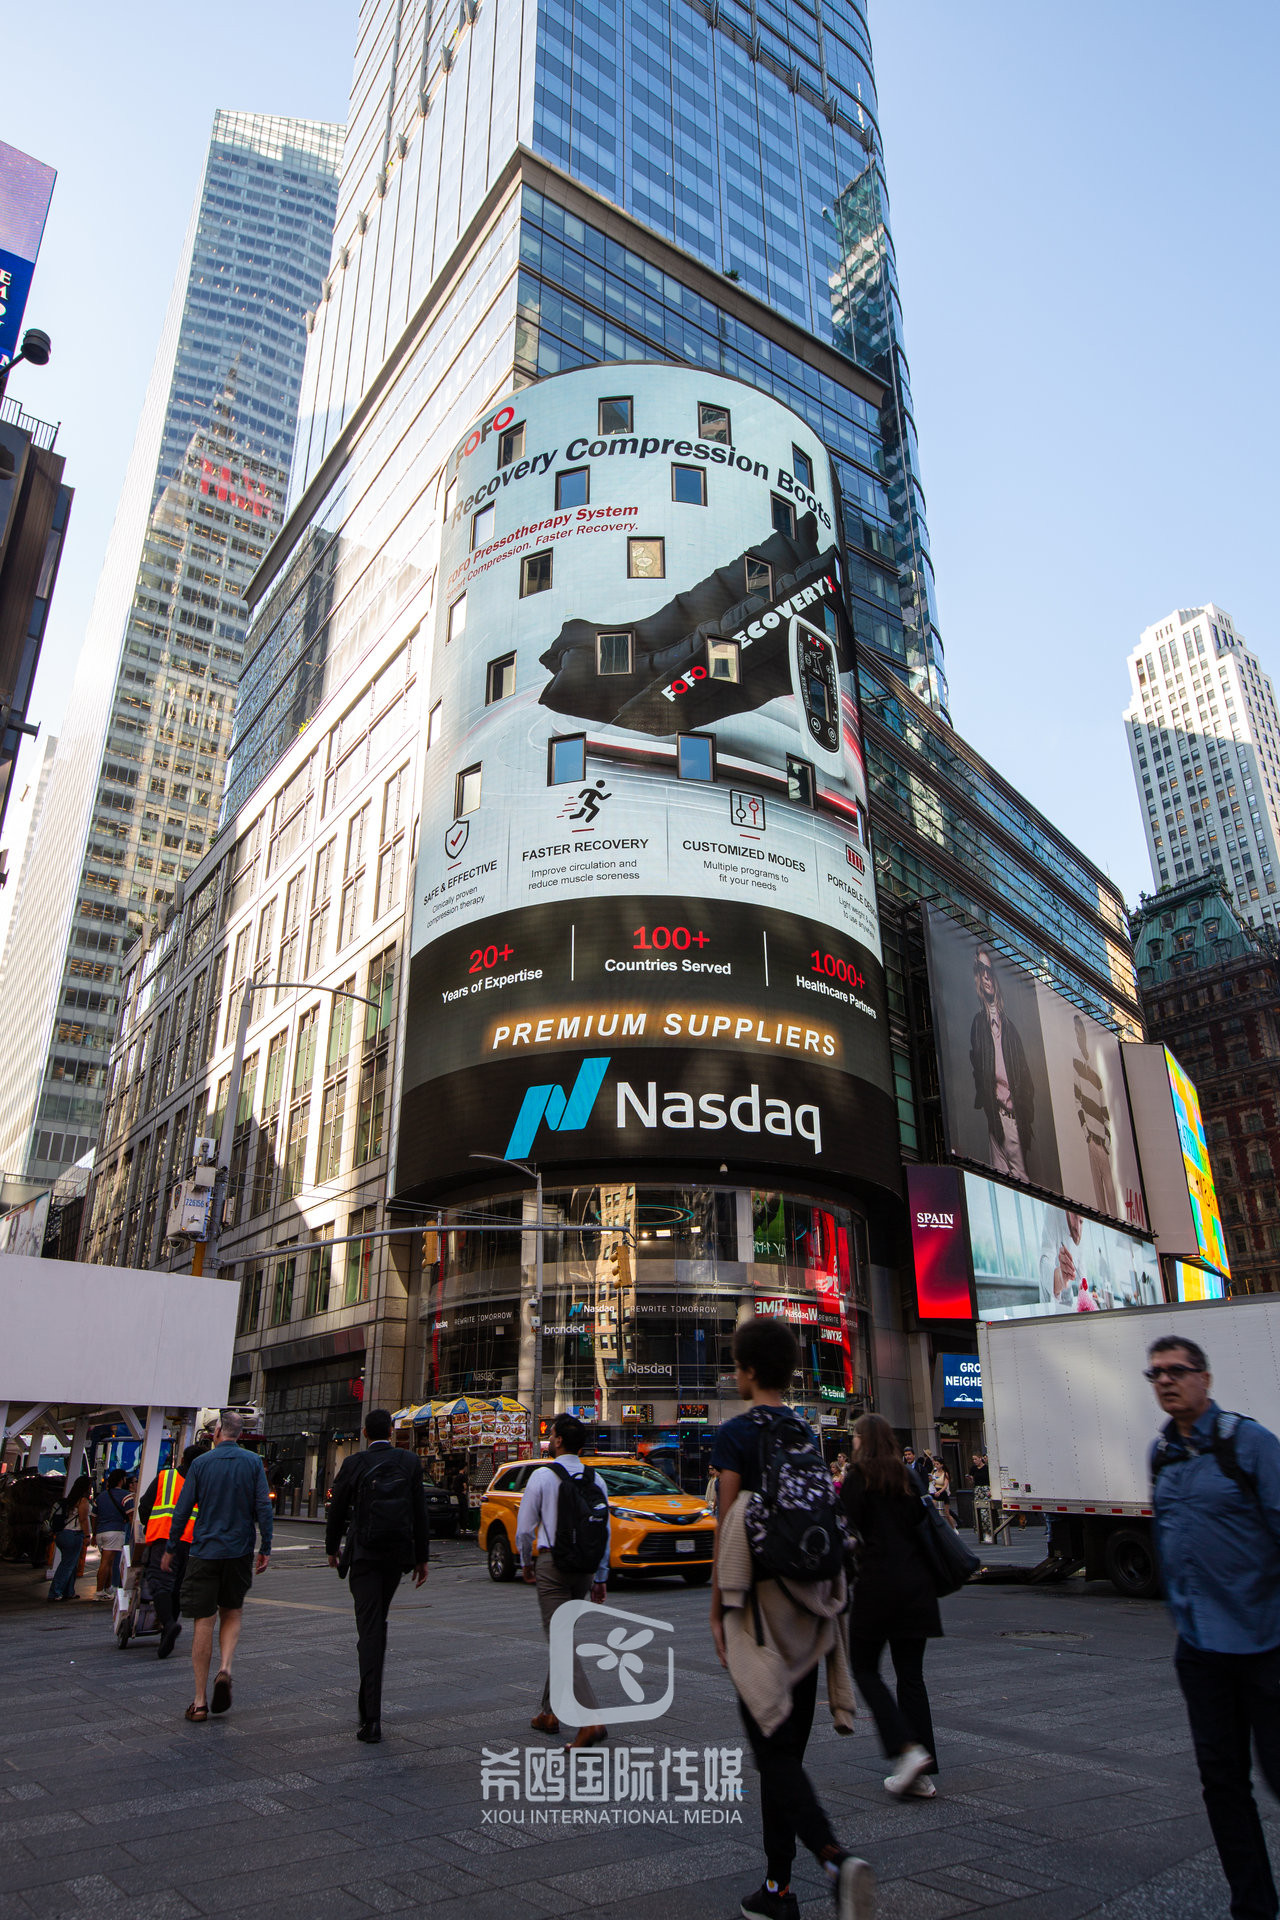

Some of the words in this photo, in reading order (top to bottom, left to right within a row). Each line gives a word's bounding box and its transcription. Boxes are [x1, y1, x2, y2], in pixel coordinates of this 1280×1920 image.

[456, 407, 515, 470] FOFO
[451, 449, 558, 529] Recovery
[566, 437, 768, 480] Compression
[777, 468, 831, 530] Boots
[473, 514, 572, 564] Pressotherapy
[576, 506, 638, 521] System
[467, 542, 531, 582] Compression.
[535, 528, 573, 546] Faster
[577, 522, 638, 535] Recovery.
[661, 666, 707, 702] FOFO
[522, 844, 570, 861] FASTER
[575, 839, 649, 852] RECOVERY
[682, 840, 765, 860] CUSTOMIZED
[768, 853, 806, 872] MODES
[424, 886, 439, 905] SAFE
[447, 860, 497, 889] EFFECTIVE
[528, 877, 558, 890] reduce
[561, 873, 593, 885] muscle
[596, 871, 640, 881] soreness
[531, 865, 567, 879] Improve
[569, 861, 615, 873] circulation
[619, 859, 637, 868] and
[703, 860, 738, 874] Multiple
[741, 866, 779, 882] programs
[781, 874, 789, 883] to
[719, 874, 727, 882] fit
[729, 876, 749, 886] your
[751, 880, 777, 892] needs
[456, 886, 478, 902] proven
[828, 873, 863, 904] PORTABLE
[427, 905, 459, 928] compression
[460, 895, 485, 909] therapy
[633, 926, 710, 950] 100+
[469, 944, 514, 974] 20+
[605, 959, 678, 971] Countries
[682, 959, 731, 975] Served
[811, 950, 865, 988] 1000+
[442, 983, 468, 1003] Years
[471, 979, 482, 993] of
[484, 968, 543, 990] Expertise
[796, 975, 848, 1002] Healthcare
[850, 994, 877, 1019] Partners
[493, 1013, 647, 1049] PREMIUM
[663, 1013, 836, 1056] SUPPLIERS
[617, 1081, 822, 1154] Nasdaq
[917, 1213, 953, 1225] SPAIN
[478, 1311, 513, 1322] TOMORROW
[584, 1303, 614, 1315] Nasdaq
[631, 1305, 667, 1313] REWRITE
[671, 1305, 717, 1313] TOMORROW
[628, 1362, 672, 1377] Nasdaq
